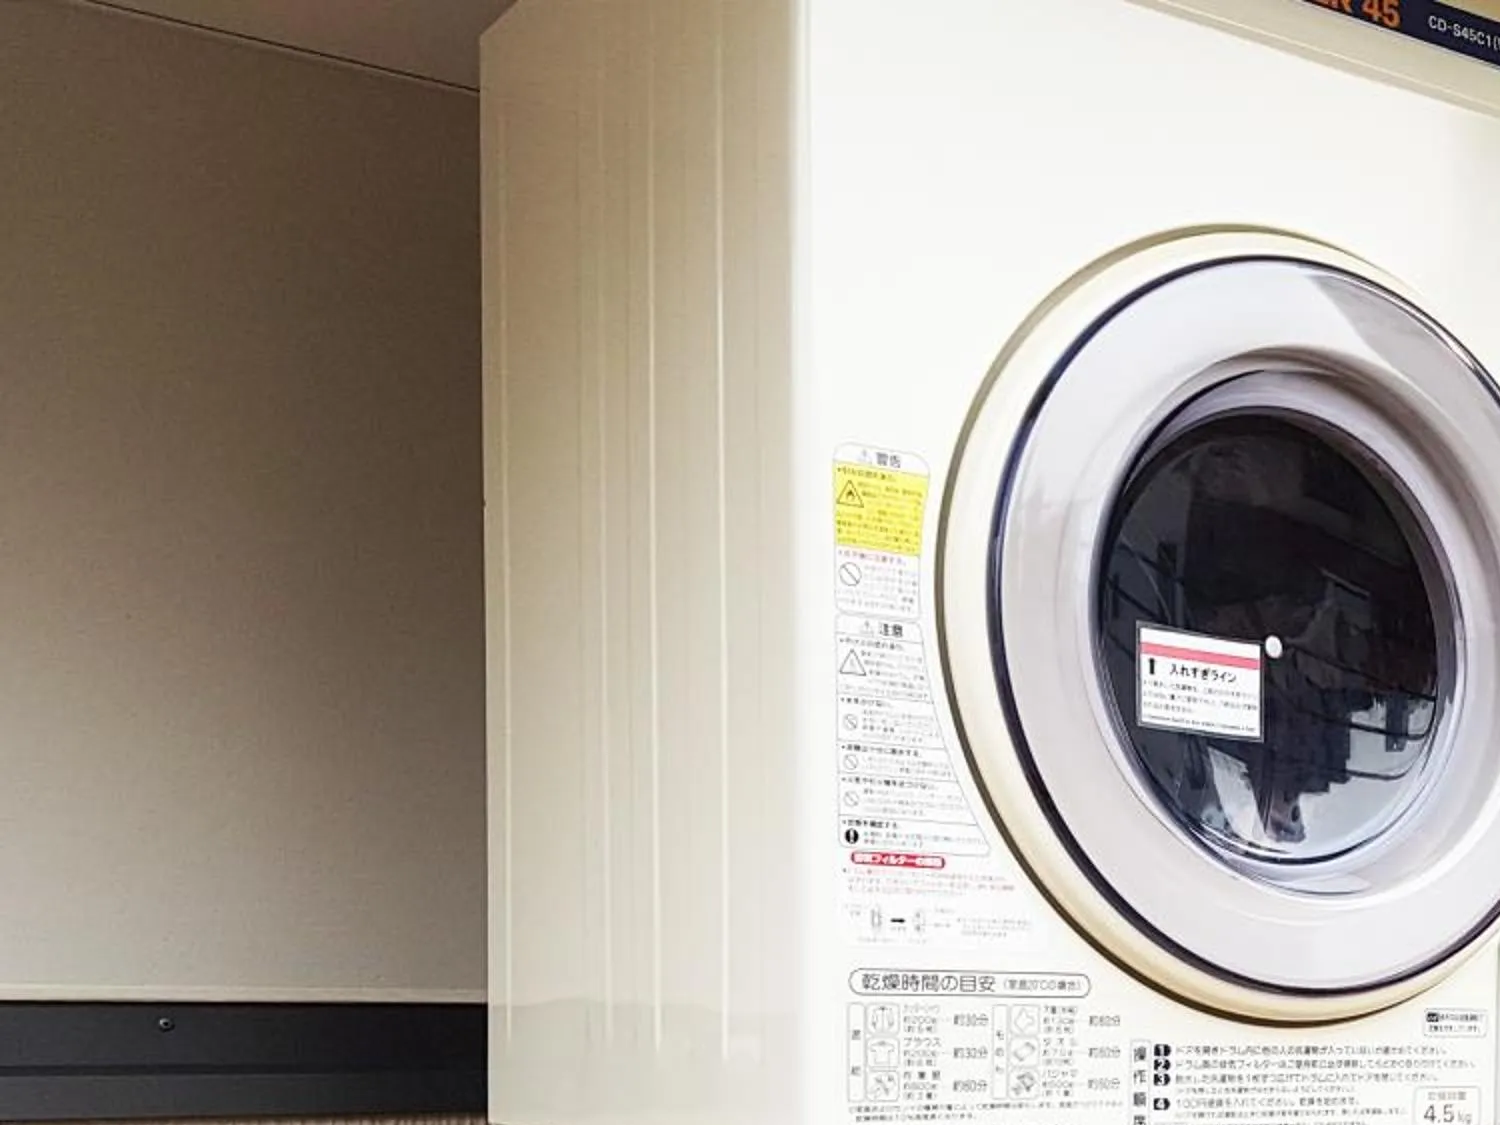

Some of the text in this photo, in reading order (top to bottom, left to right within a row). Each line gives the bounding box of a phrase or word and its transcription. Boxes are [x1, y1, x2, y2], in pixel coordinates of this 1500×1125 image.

[1169, 663, 1237, 683] 入れすぎライン
[862, 973, 996, 993] 乾燥時間の目安
